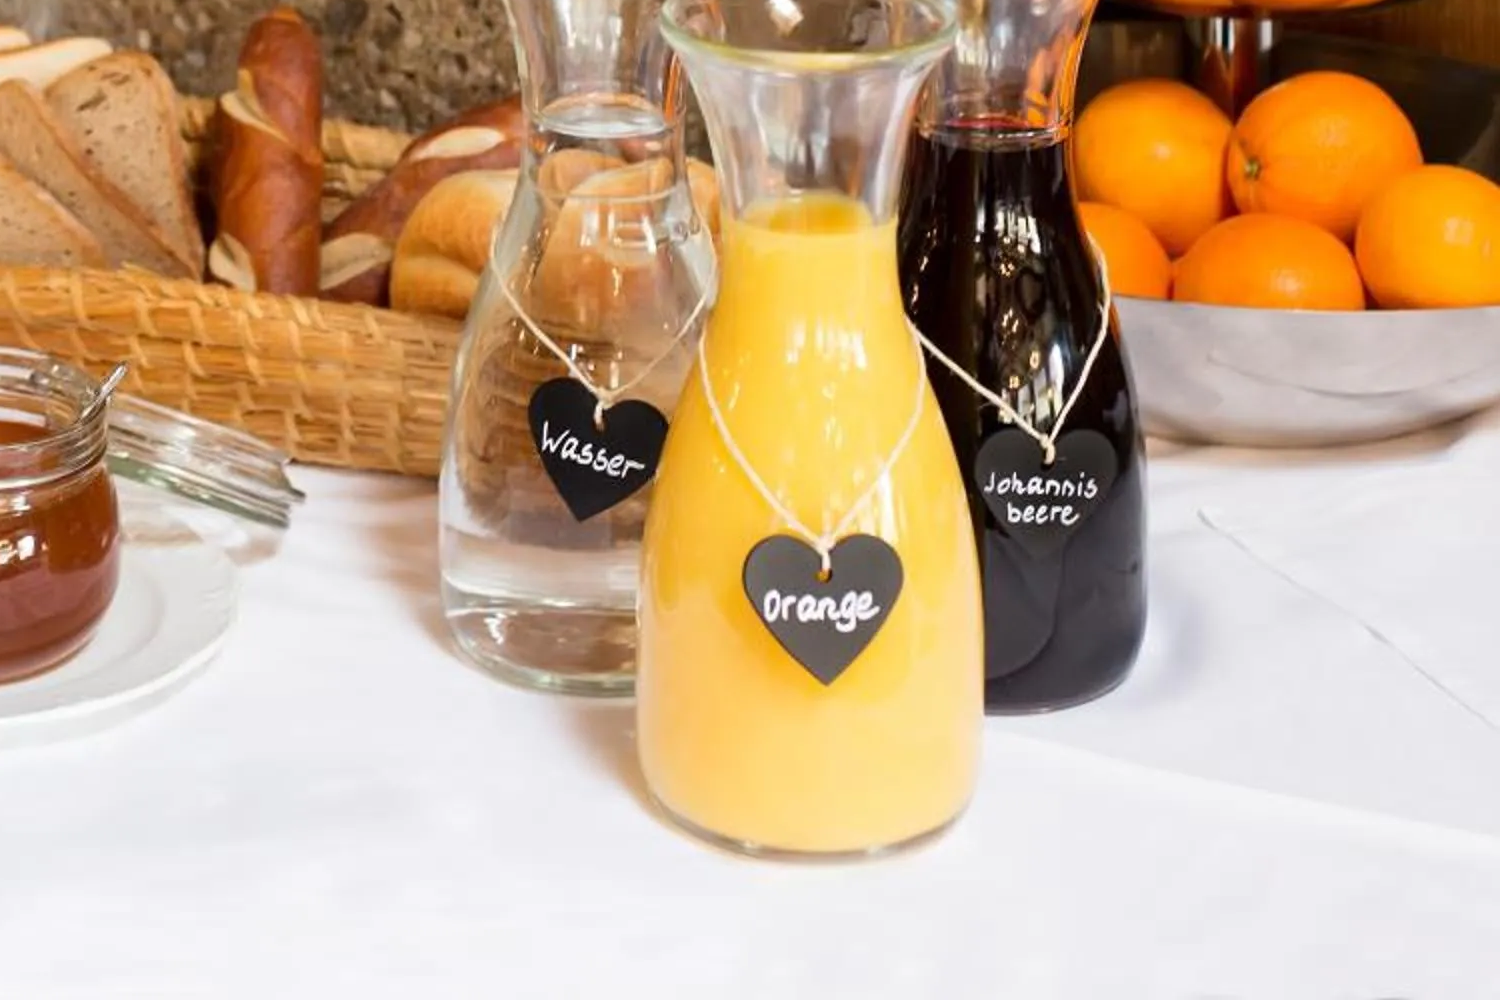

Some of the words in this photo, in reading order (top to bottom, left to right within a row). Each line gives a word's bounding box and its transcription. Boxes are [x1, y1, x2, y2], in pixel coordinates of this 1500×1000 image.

[541, 419, 645, 479] Wasser
[983, 471, 1099, 499] Johannis
[1006, 501, 1081, 526] beere
[763, 589, 881, 633] Orange
